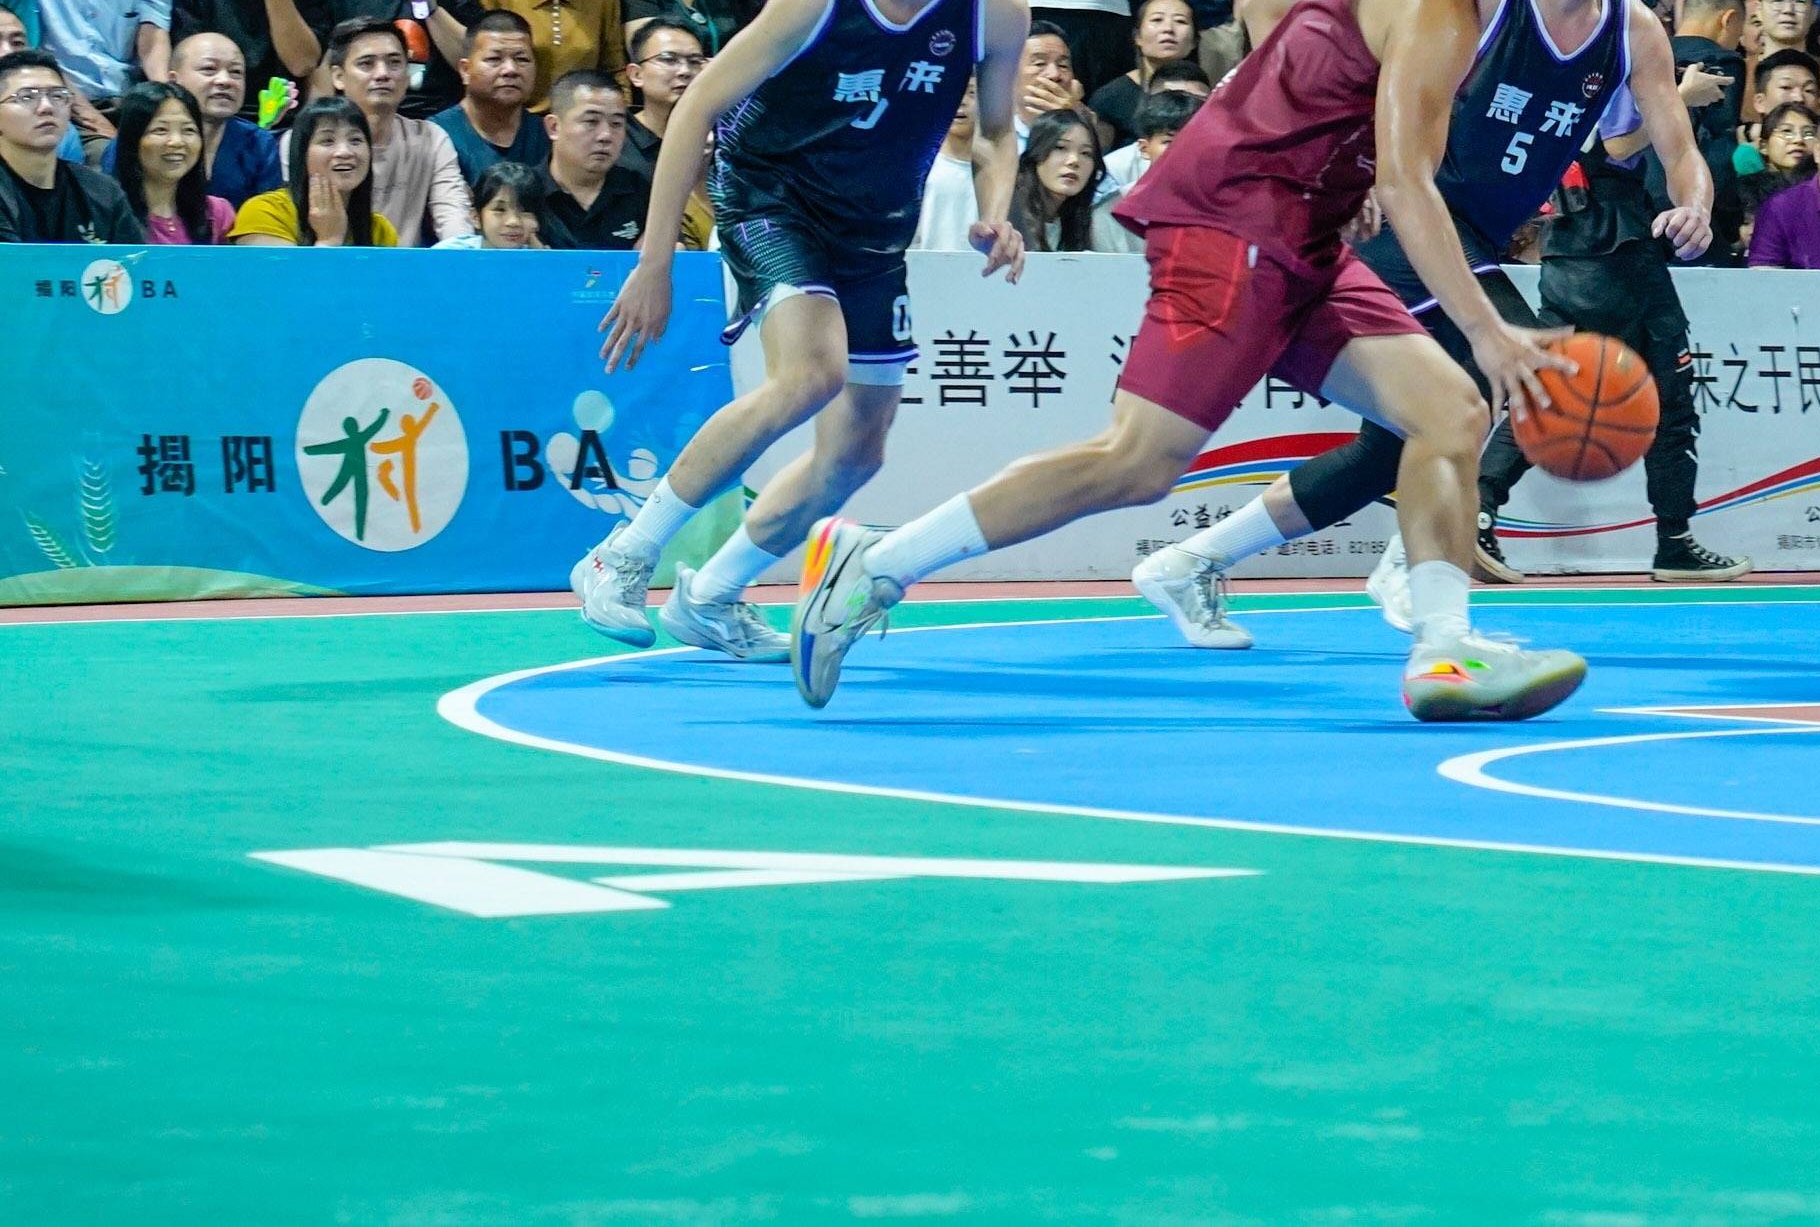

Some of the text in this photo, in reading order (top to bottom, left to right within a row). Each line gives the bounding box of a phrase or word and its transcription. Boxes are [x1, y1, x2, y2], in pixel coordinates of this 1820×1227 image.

[832, 60, 946, 103] 惠来
[1485, 82, 1586, 138] 惠来
[1500, 131, 1535, 175] 5
[35, 279, 76, 297] 揭阳
[141, 279, 178, 298] BA
[900, 329, 1067, 409] 善举
[136, 433, 276, 498] 揭阳
[500, 429, 617, 493] BA
